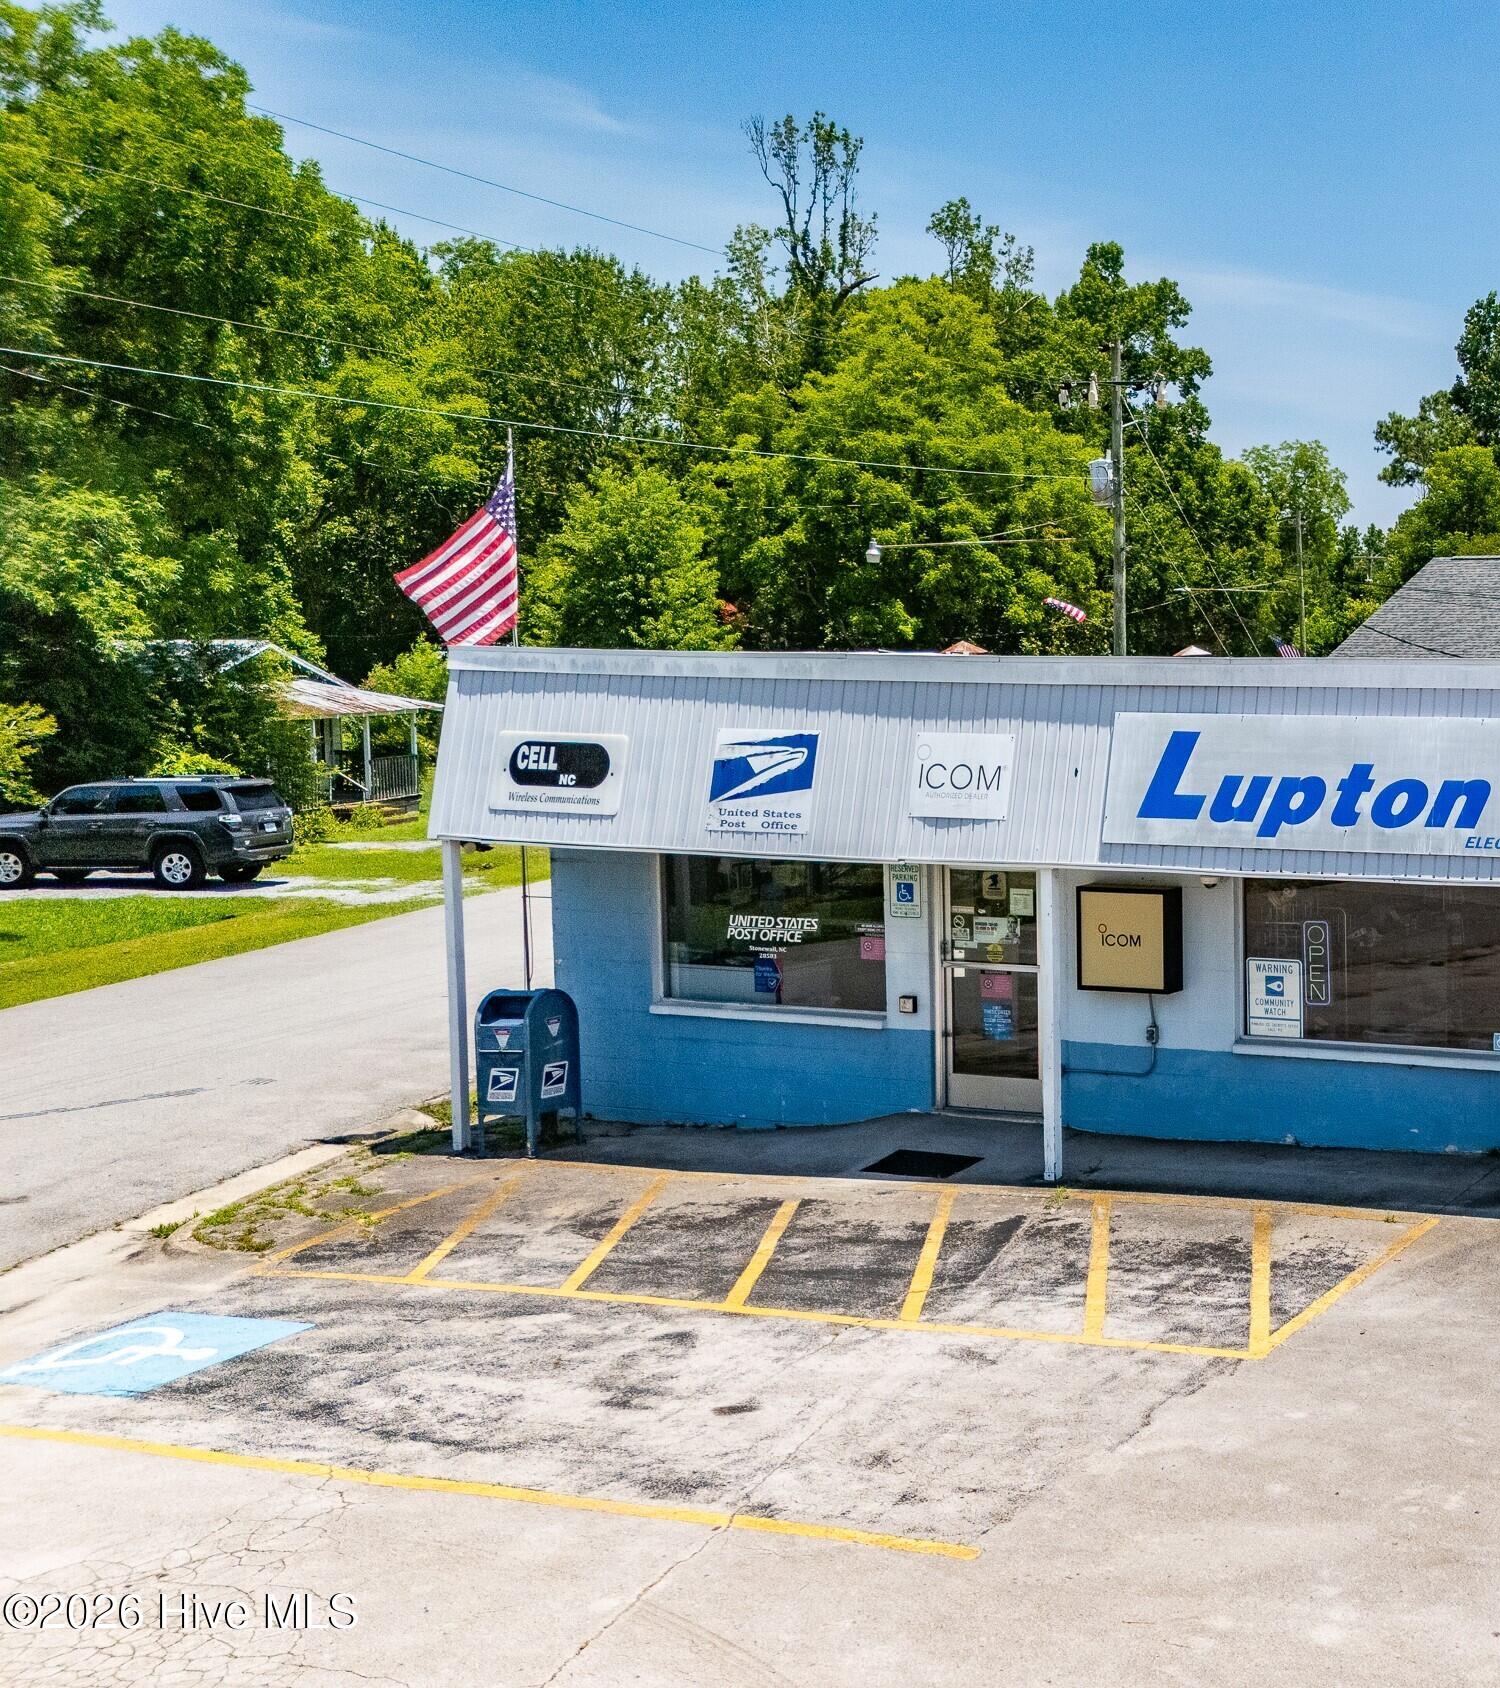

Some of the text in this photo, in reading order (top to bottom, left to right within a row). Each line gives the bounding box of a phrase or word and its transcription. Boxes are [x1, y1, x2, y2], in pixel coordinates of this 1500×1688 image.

[516, 745, 558, 770] CELL
[558, 774, 576, 785] NC
[918, 763, 1002, 791] ICOM
[508, 791, 601, 806] Wireless Communications
[925, 791, 989, 801] AUTHORIZED DEALER
[718, 807, 802, 820] United States
[719, 819, 798, 831] Post Office
[890, 863, 920, 872] RESERVED
[892, 873, 918, 881] PARKING
[728, 914, 819, 930] UNITED STATES
[726, 928, 803, 943] POST OFFICE
[1101, 933, 1142, 948] ICOM
[1255, 963, 1293, 974] WARNING
[1307, 925, 1326, 1001] OPEN
[1254, 997, 1295, 1008] COMMUNITY
[1263, 1007, 1286, 1016] WATCH
